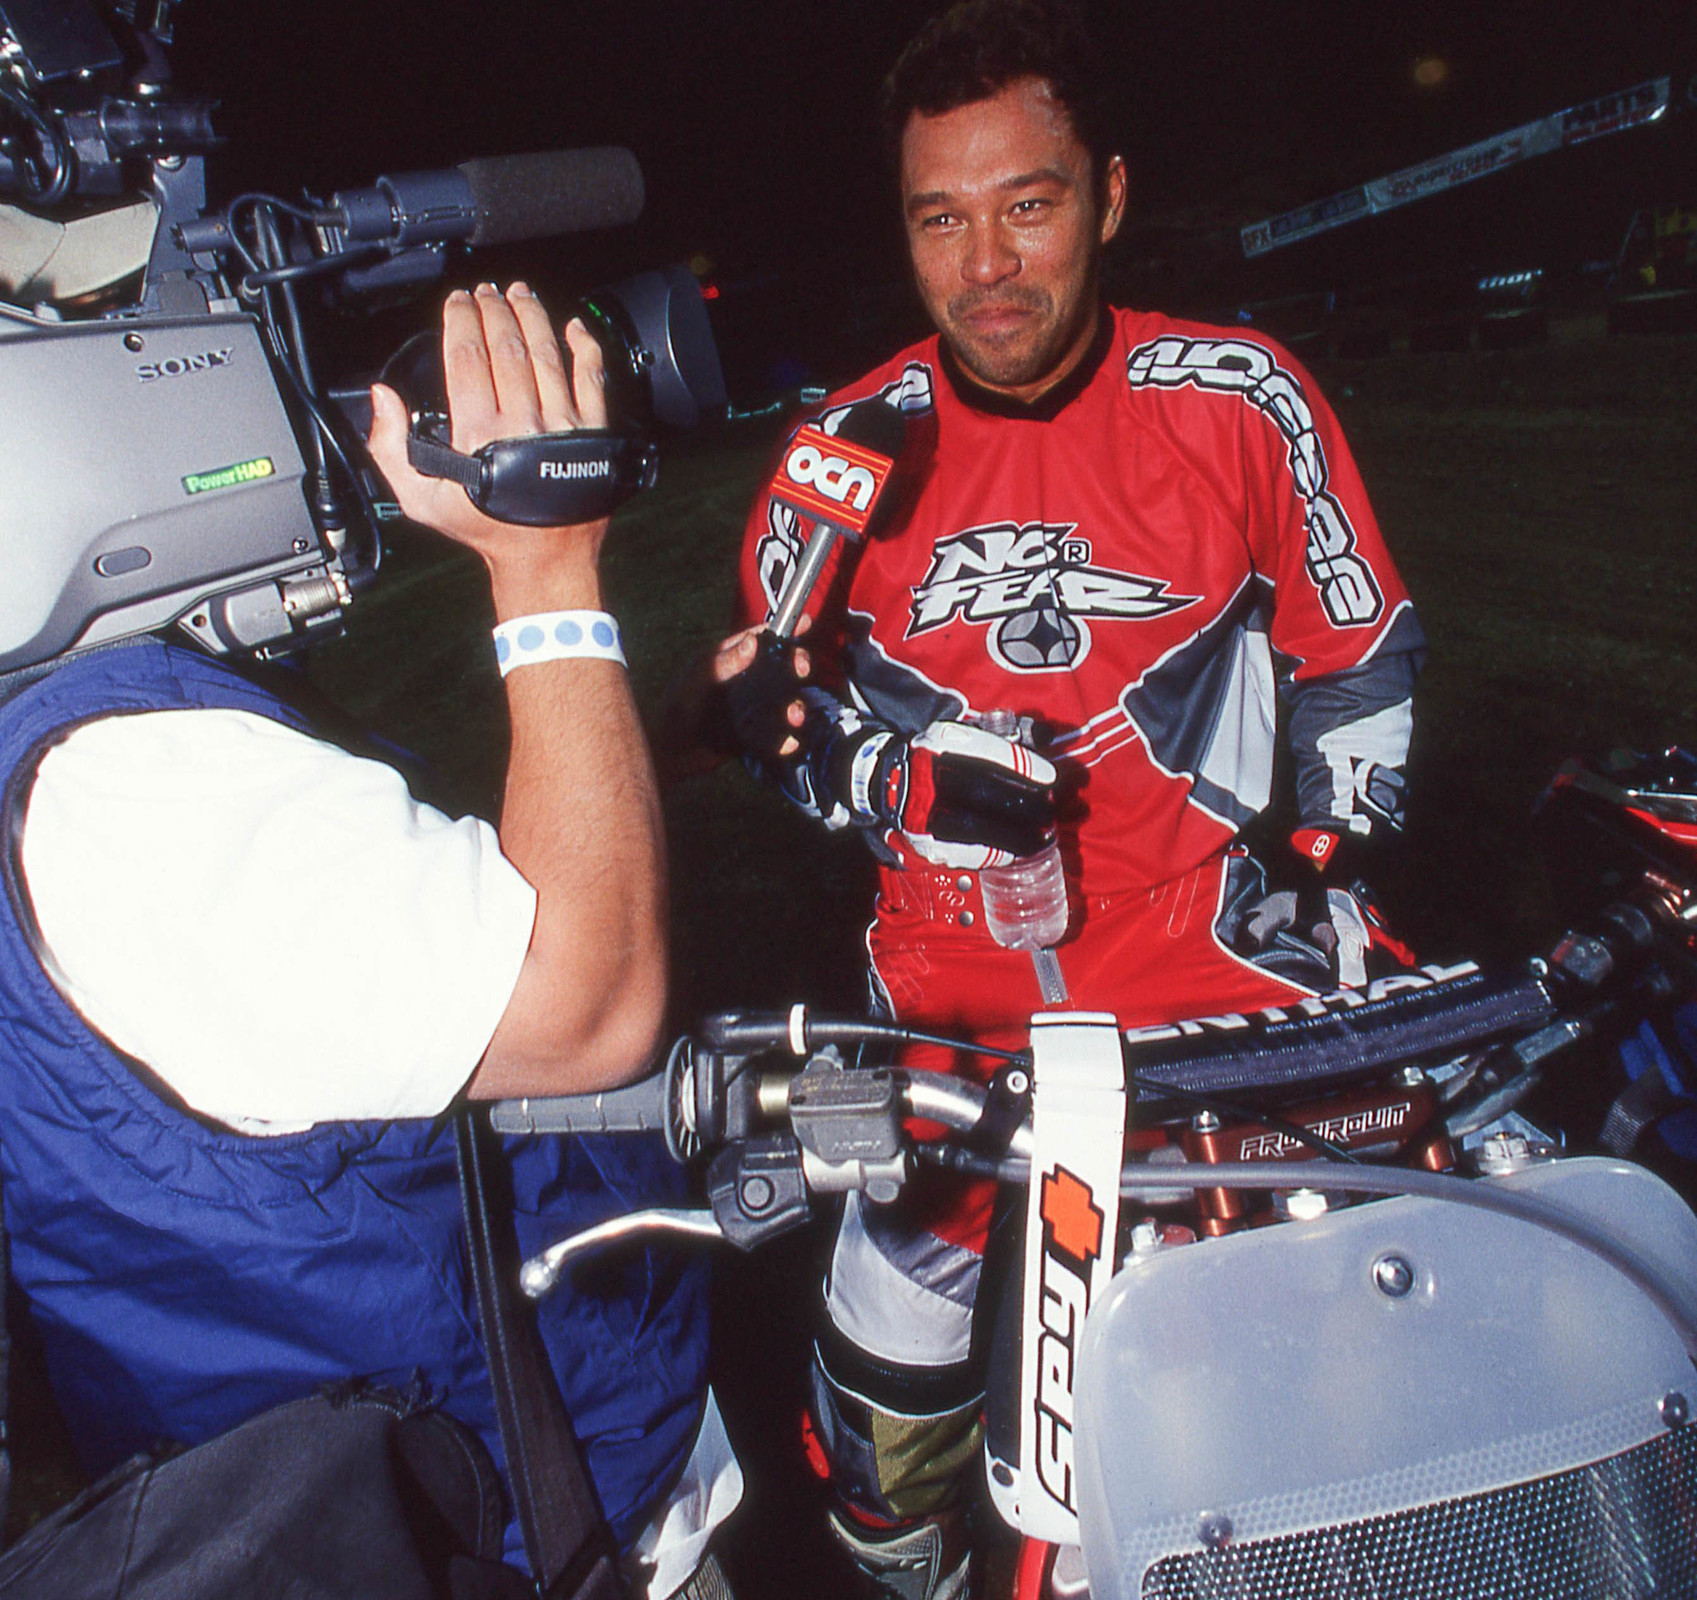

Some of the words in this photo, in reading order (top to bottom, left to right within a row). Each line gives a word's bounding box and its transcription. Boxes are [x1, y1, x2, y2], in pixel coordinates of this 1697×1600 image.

[135, 348, 234, 383] SONY
[540, 460, 610, 479] FUJINON
[928, 526, 1062, 585] NO
[908, 566, 1186, 634] FEAR
[1035, 1249, 1088, 1517] SPY
